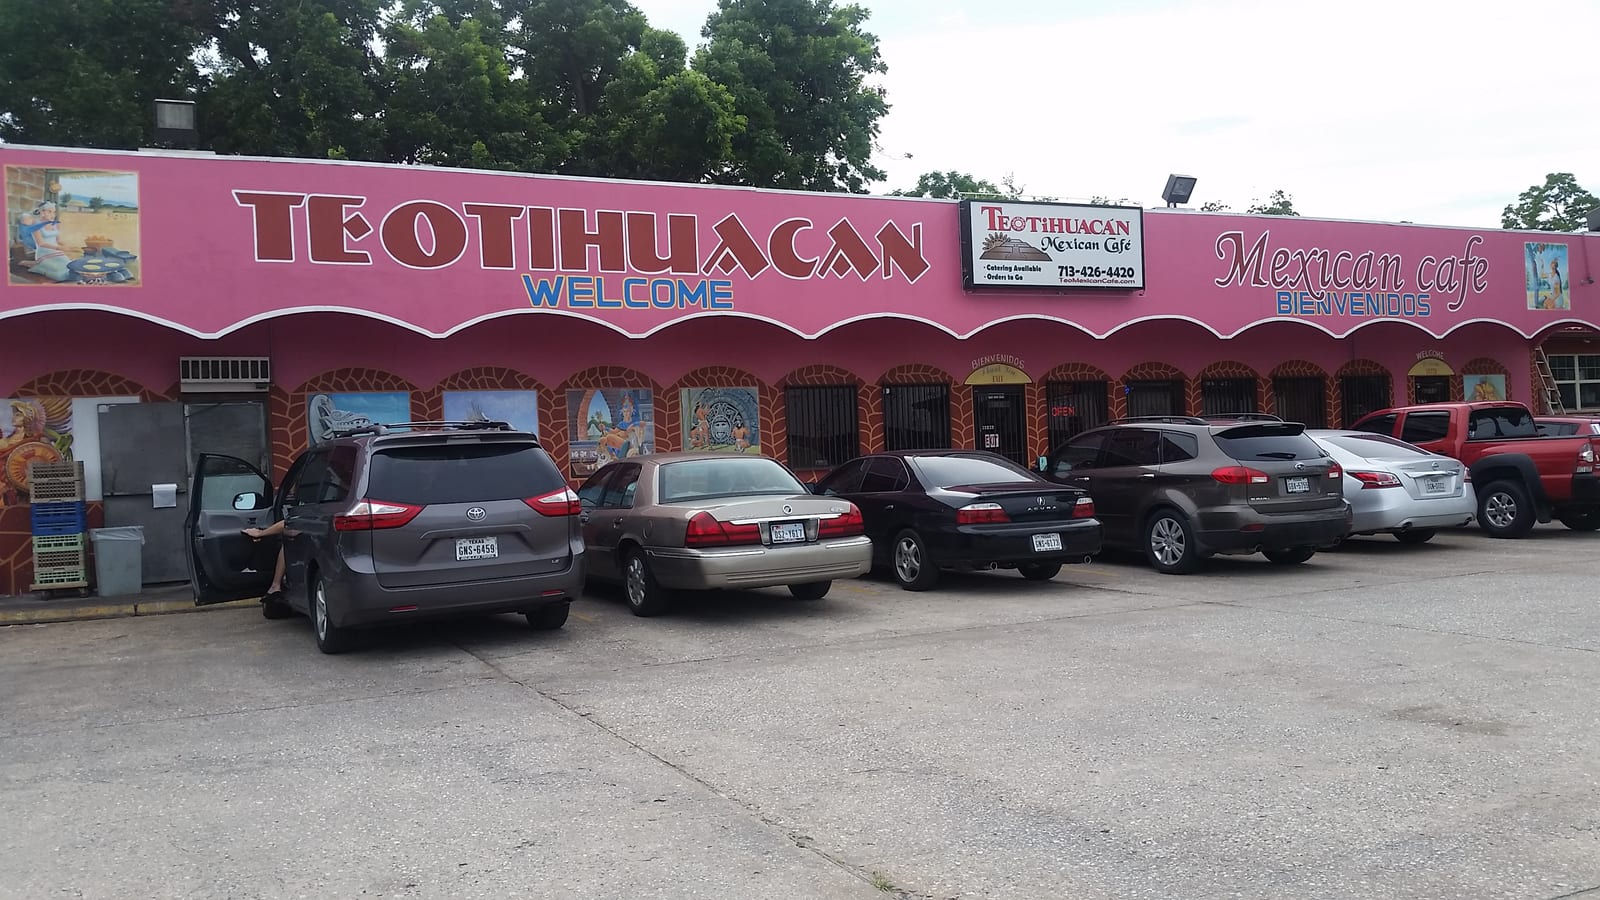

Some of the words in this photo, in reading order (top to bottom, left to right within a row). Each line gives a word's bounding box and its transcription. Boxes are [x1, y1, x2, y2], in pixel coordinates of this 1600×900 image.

[231, 189, 931, 285] TEOTIHUACAN
[1041, 236, 1100, 252] Mexican
[1104, 237, 1131, 254] Café
[986, 264, 1012, 273] Catering
[1013, 265, 1042, 273] Available
[986, 273, 1007, 281] Orders
[1058, 265, 1135, 278] 713-426-4420
[1214, 229, 1405, 302] Mexican
[1416, 235, 1489, 313] cafe
[520, 273, 735, 310] WELCOME
[1276, 290, 1432, 317] BIENVENIDOS
[971, 353, 1025, 370] BIENVENIDOS
[1415, 349, 1444, 360] WELCOME
[1051, 406, 1075, 417] OPEN
